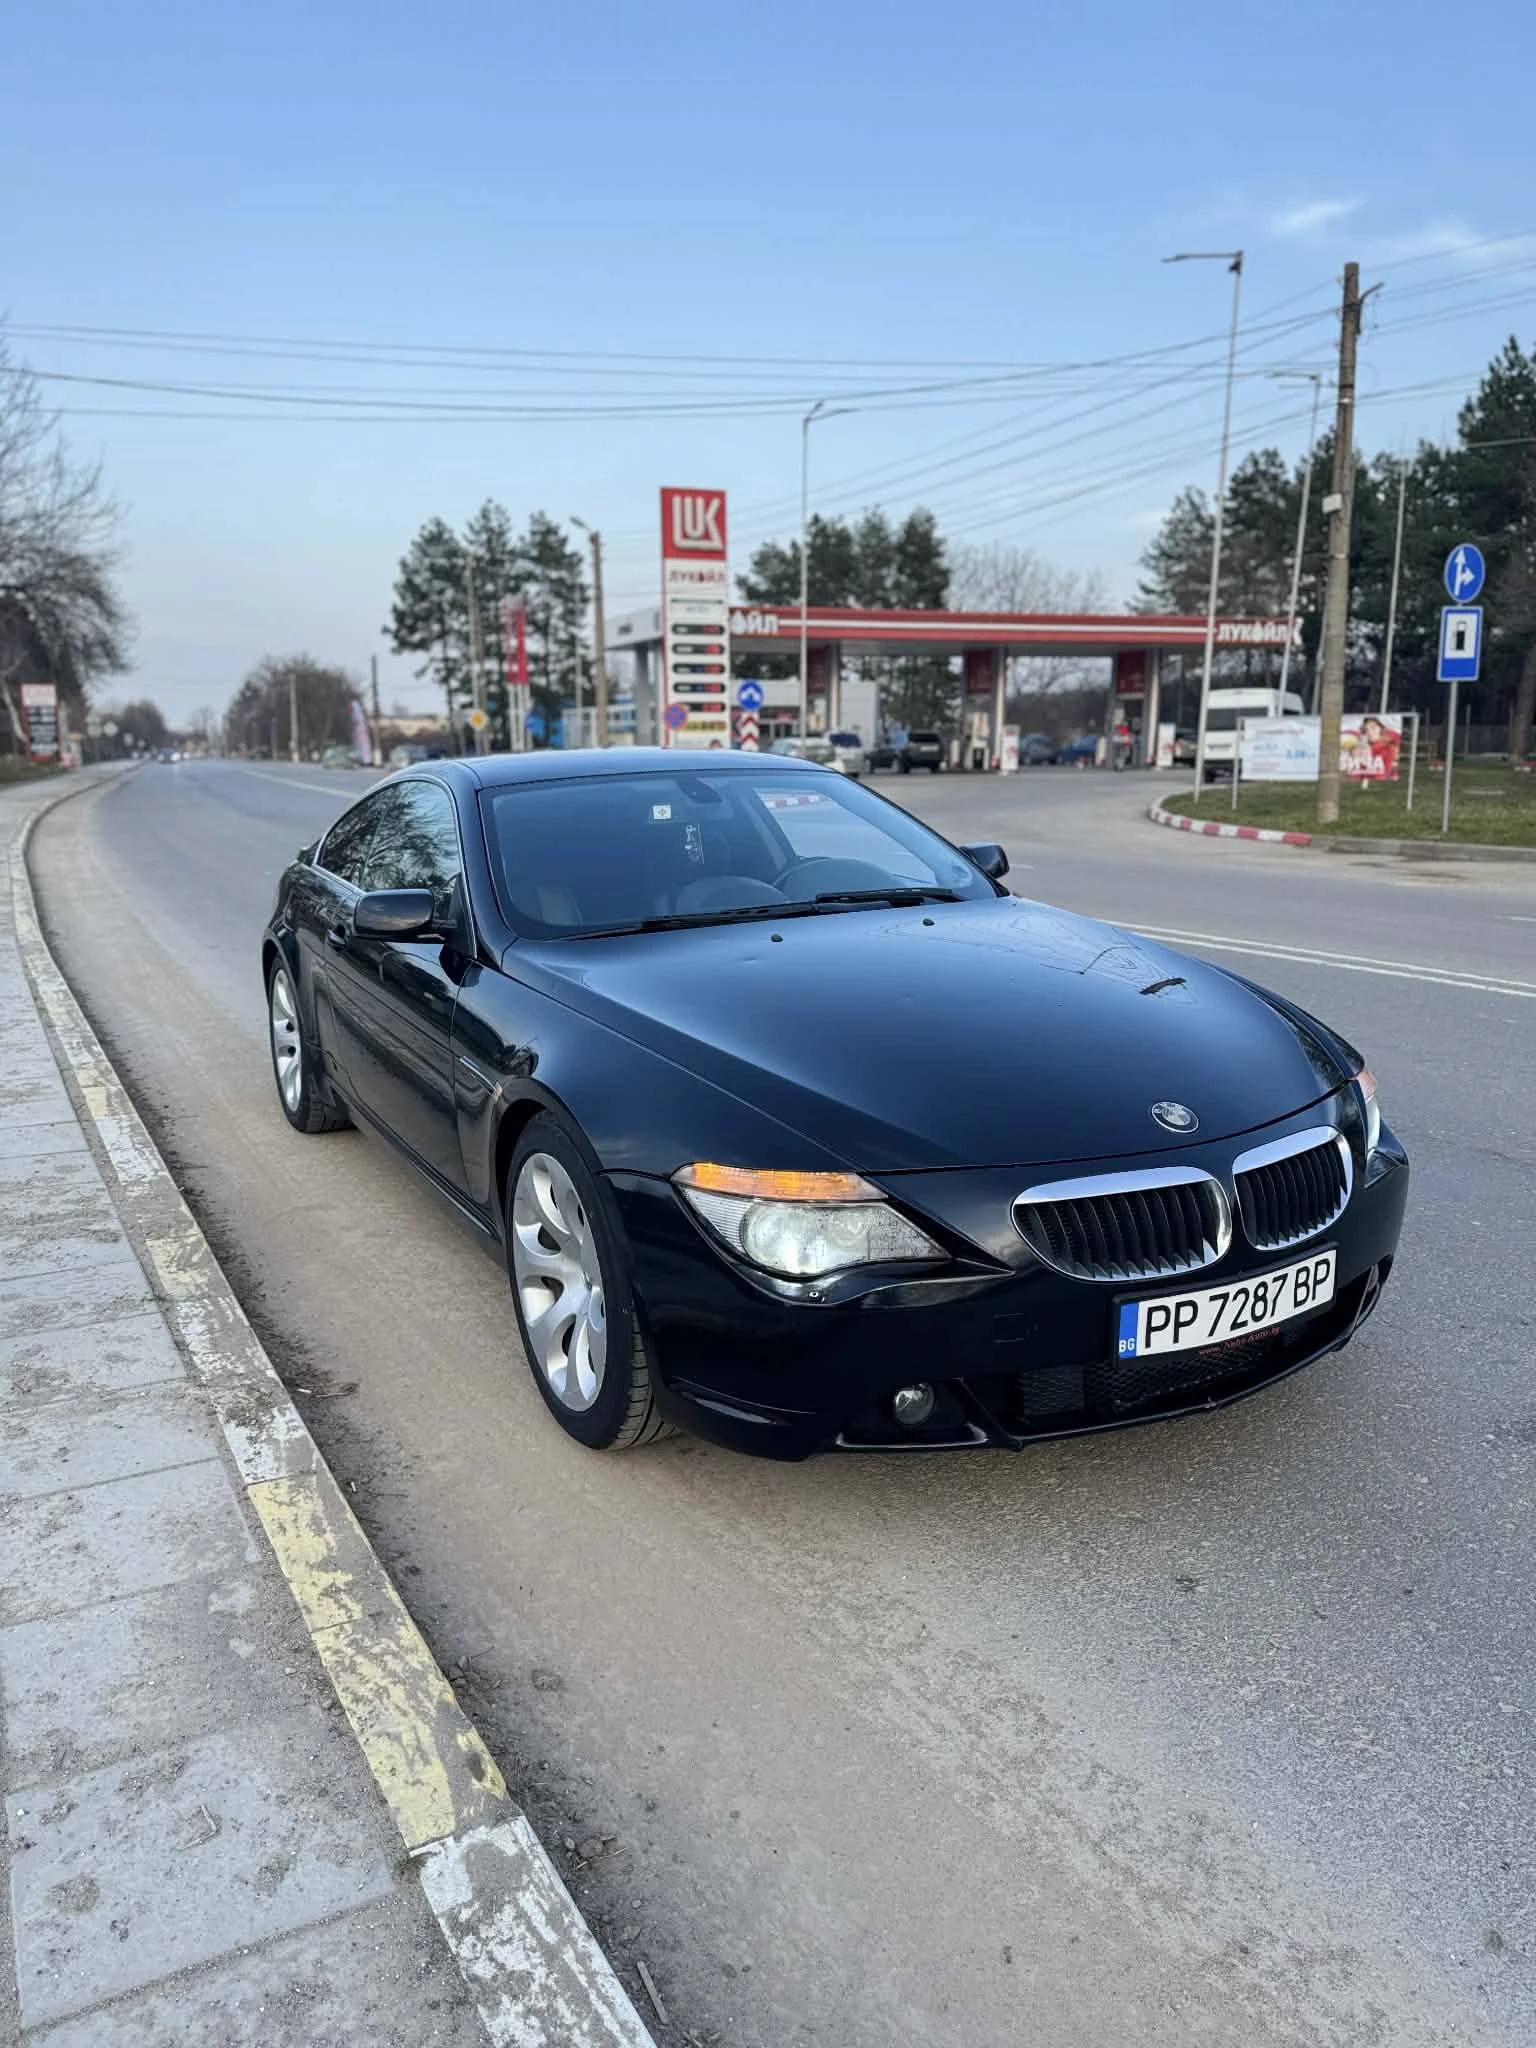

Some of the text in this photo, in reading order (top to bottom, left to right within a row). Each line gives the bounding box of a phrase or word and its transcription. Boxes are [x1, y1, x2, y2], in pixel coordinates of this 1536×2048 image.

[1143, 1257, 1332, 1349] PP 7287 BP
[1118, 1337, 1136, 1353] BG
